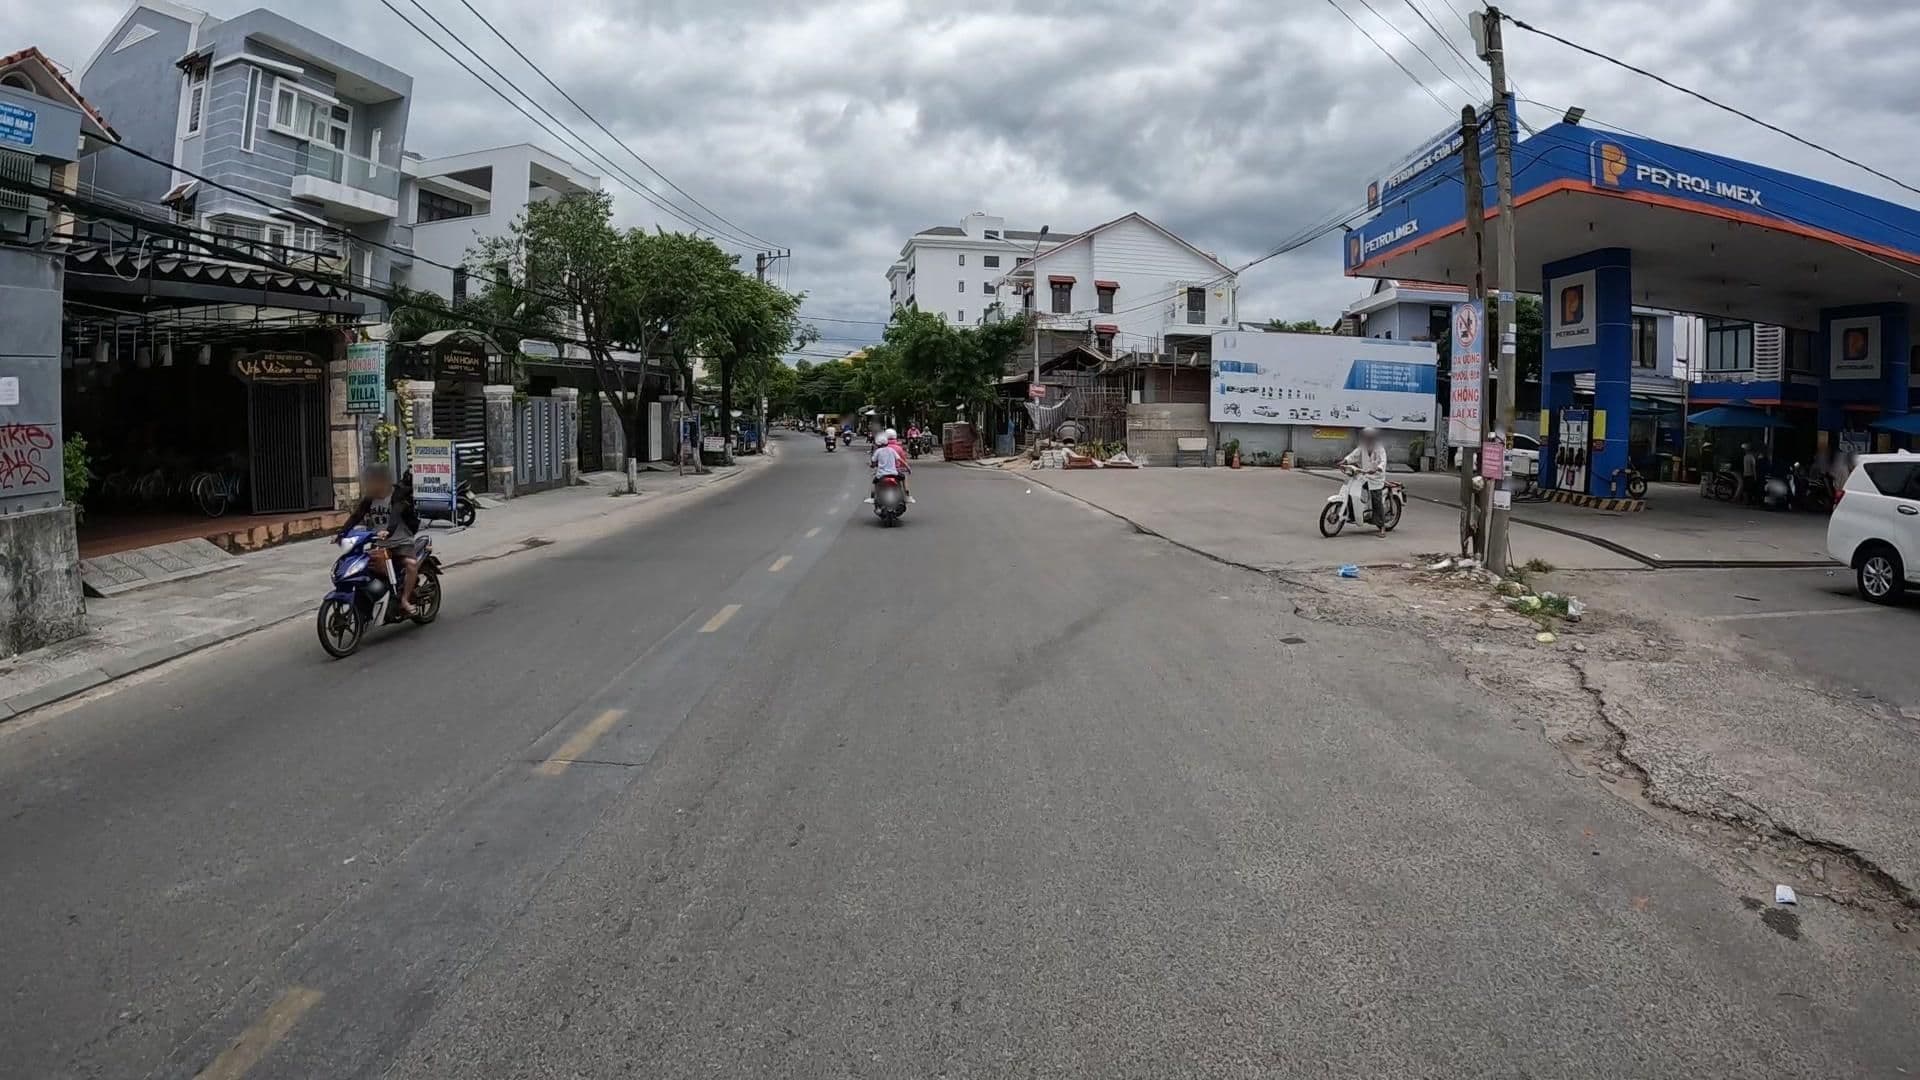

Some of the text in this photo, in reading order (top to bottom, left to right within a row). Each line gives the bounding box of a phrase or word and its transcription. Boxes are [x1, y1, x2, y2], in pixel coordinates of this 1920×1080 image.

[1636, 163, 1762, 206] PETROLIMEX
[1365, 219, 1418, 253] PETROLIMEX
[350, 387, 376, 400] VILLA
[1452, 386, 1479, 402] KHÔNG
[1466, 408, 1478, 419] XE
